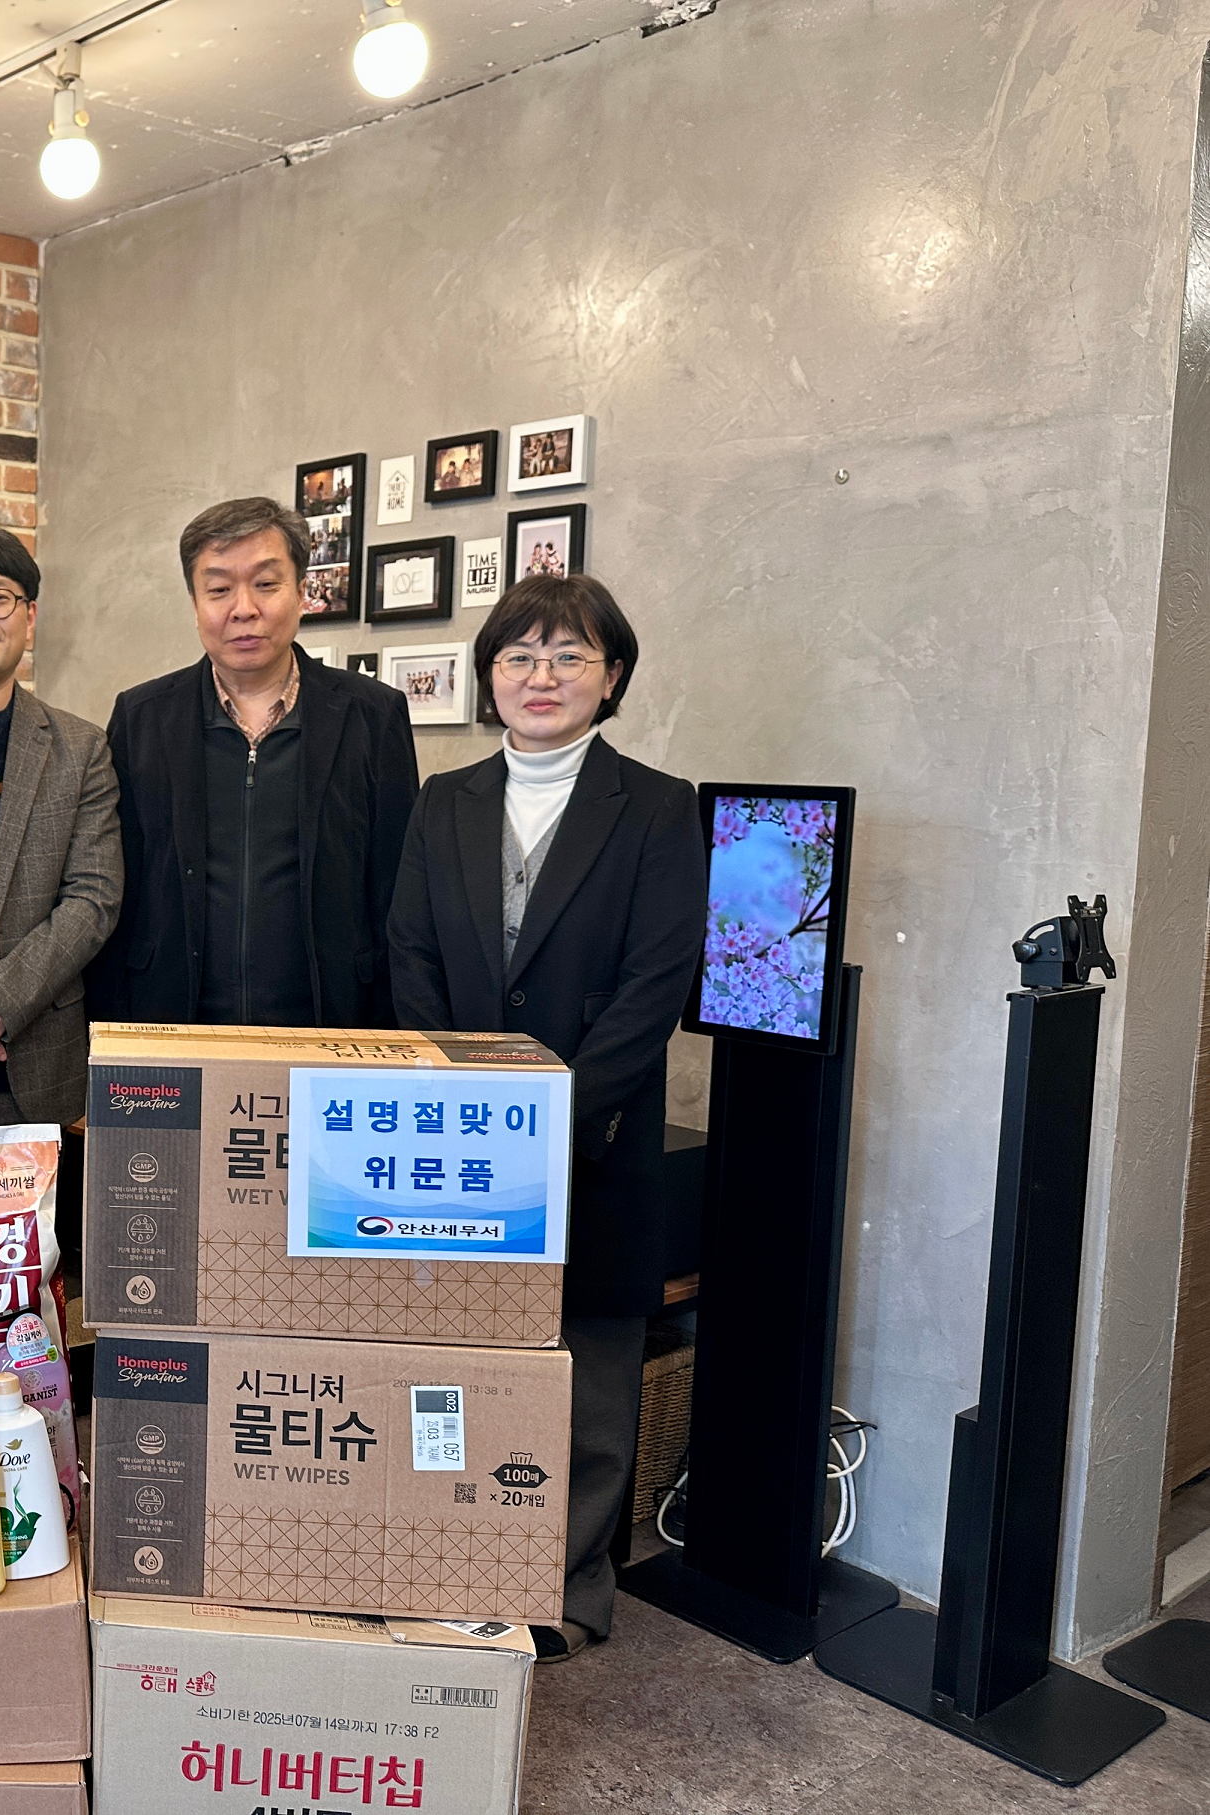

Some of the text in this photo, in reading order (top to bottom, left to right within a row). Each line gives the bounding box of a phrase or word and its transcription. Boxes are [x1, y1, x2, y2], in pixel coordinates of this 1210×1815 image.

[466, 552, 497, 568] TIME
[468, 567, 496, 586] LIFE
[466, 586, 496, 595] MUSIC
[109, 1083, 181, 1098] Homeplus
[109, 1095, 181, 1114] Signature
[226, 1187, 273, 1205] WET
[396, 1221, 499, 1239] 안산세무서
[16, 1329, 42, 1343] 각질케어
[116, 1355, 188, 1372] Homeplus
[117, 1367, 187, 1387] Signature
[236, 1369, 344, 1403] 시그니처
[22, 1387, 58, 1403] GANIST
[468, 1384, 498, 1396] 13:38
[504, 1387, 513, 1396] B
[445, 1392, 457, 1412] 002
[229, 1403, 378, 1463] 물티슈
[0, 1452, 31, 1467] Dove
[443, 1442, 460, 1462] 057
[234, 1464, 350, 1486] WET WIPES
[503, 1468, 540, 1484] 100매
[501, 1490, 545, 1508] 20개입
[196, 1705, 251, 1722] 소비기한
[384, 1722, 418, 1738] 17:38
[424, 1726, 439, 1739] F2
[180, 1739, 425, 1808] 허니버터칩
